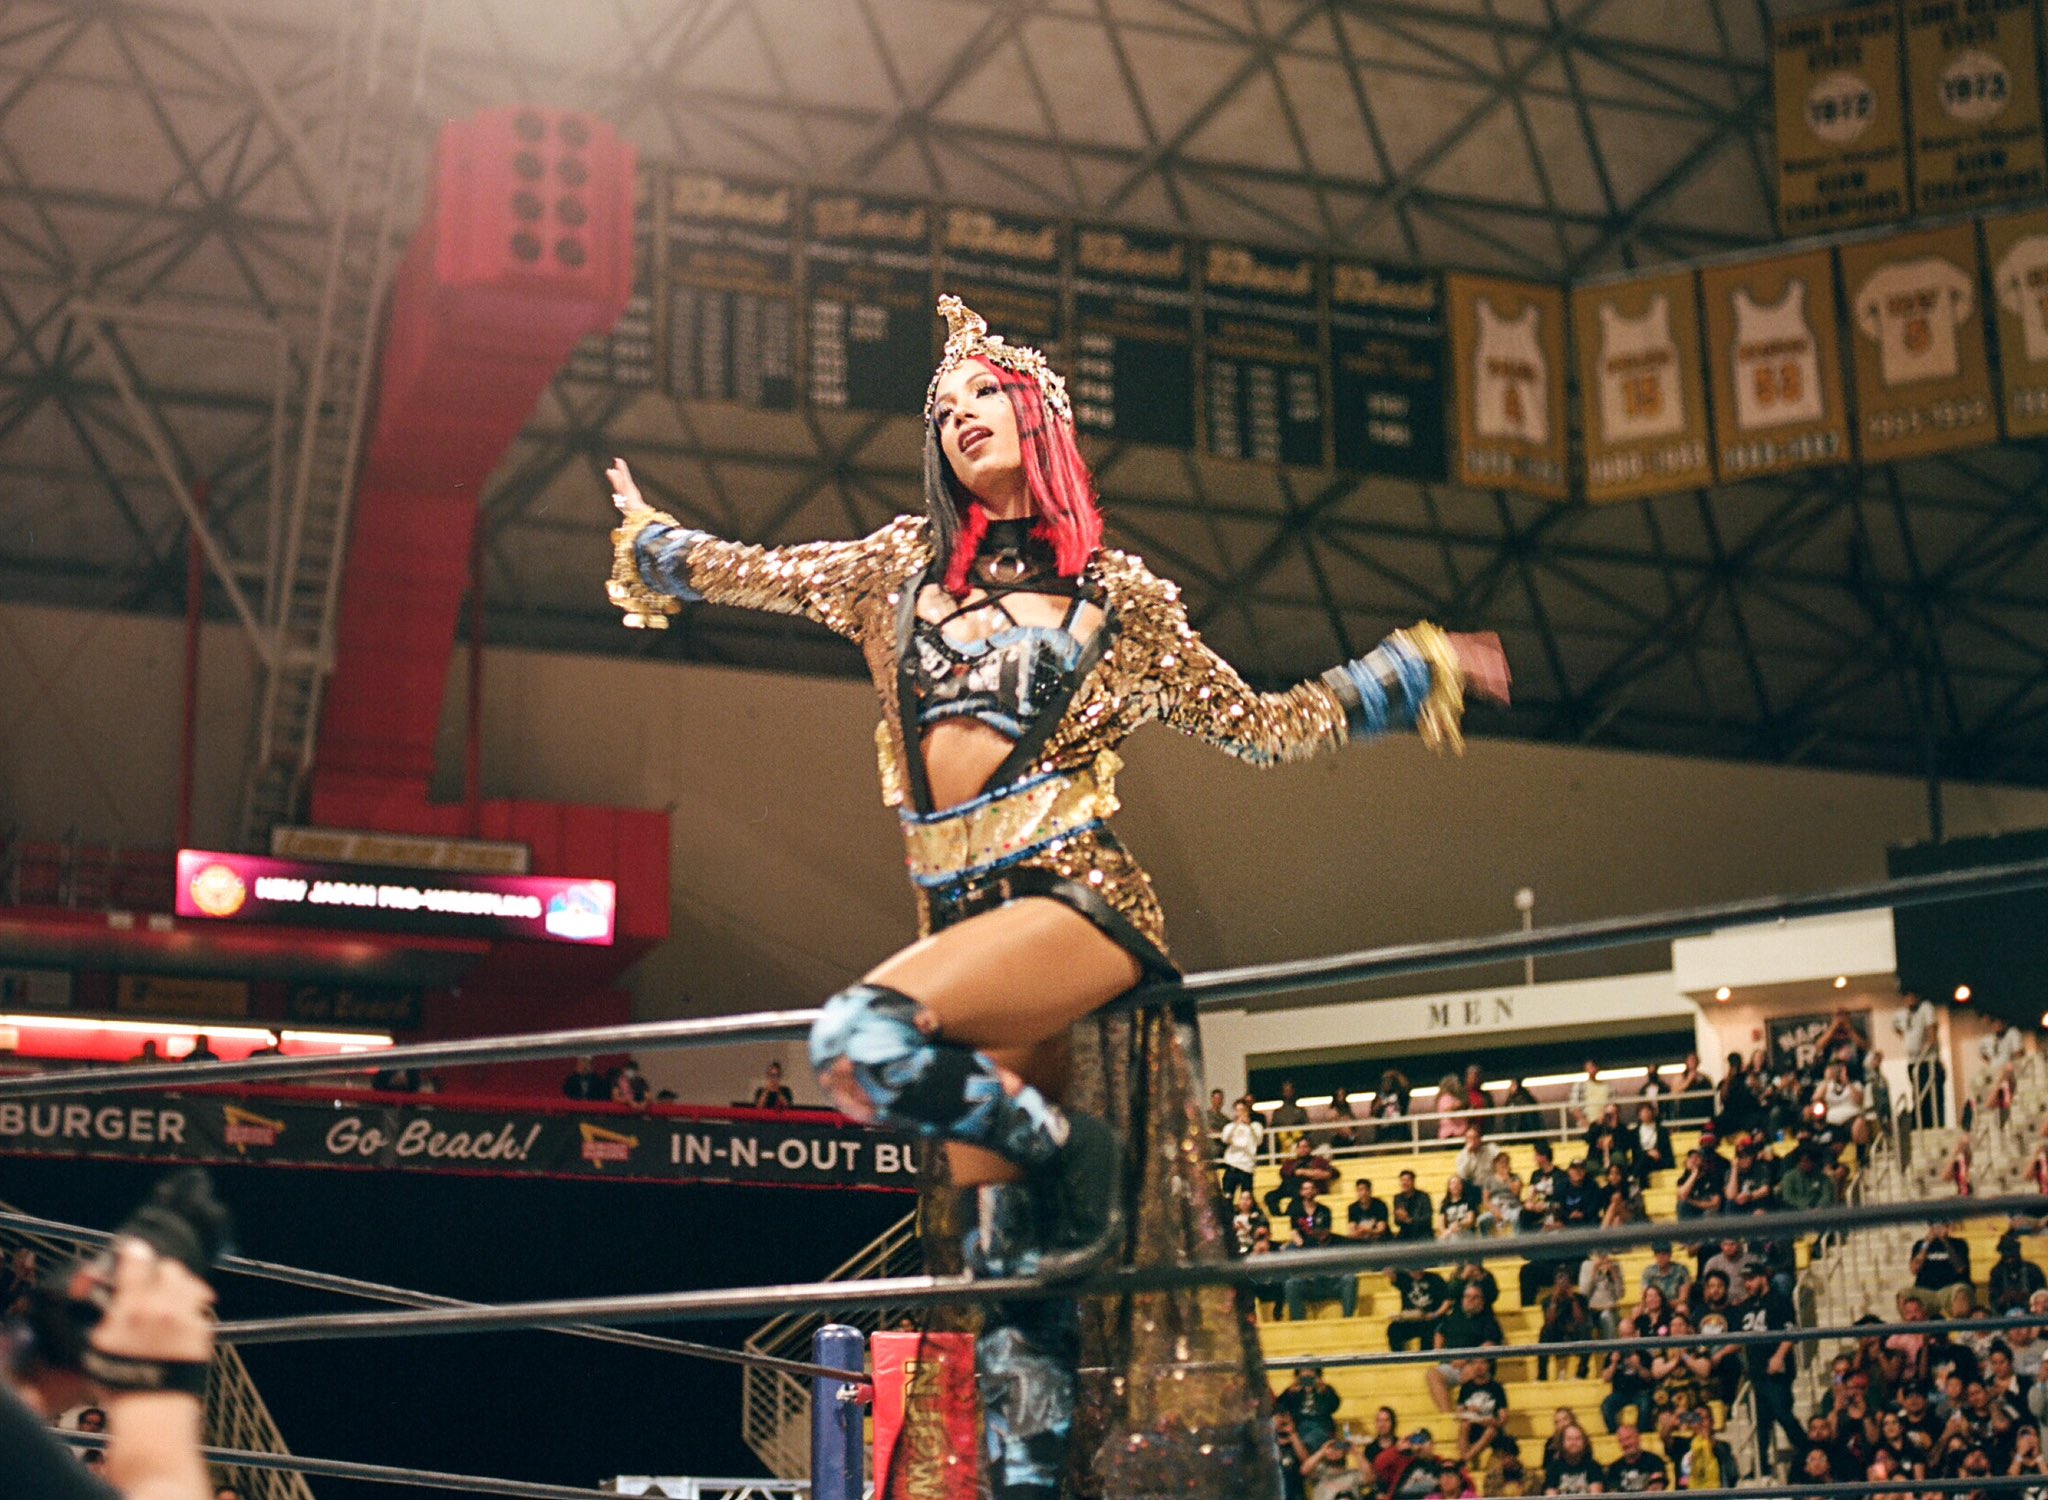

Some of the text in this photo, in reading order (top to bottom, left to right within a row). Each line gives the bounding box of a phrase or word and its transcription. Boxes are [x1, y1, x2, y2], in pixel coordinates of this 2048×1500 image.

[255, 876, 308, 902] NEW
[308, 880, 377, 907] JAPAN
[1427, 996, 1514, 1030] MEN
[0, 1102, 186, 1145] BURGER
[325, 1116, 389, 1156] Go
[395, 1118, 542, 1161] Beach!
[671, 1133, 861, 1172] IN-N-OUT
